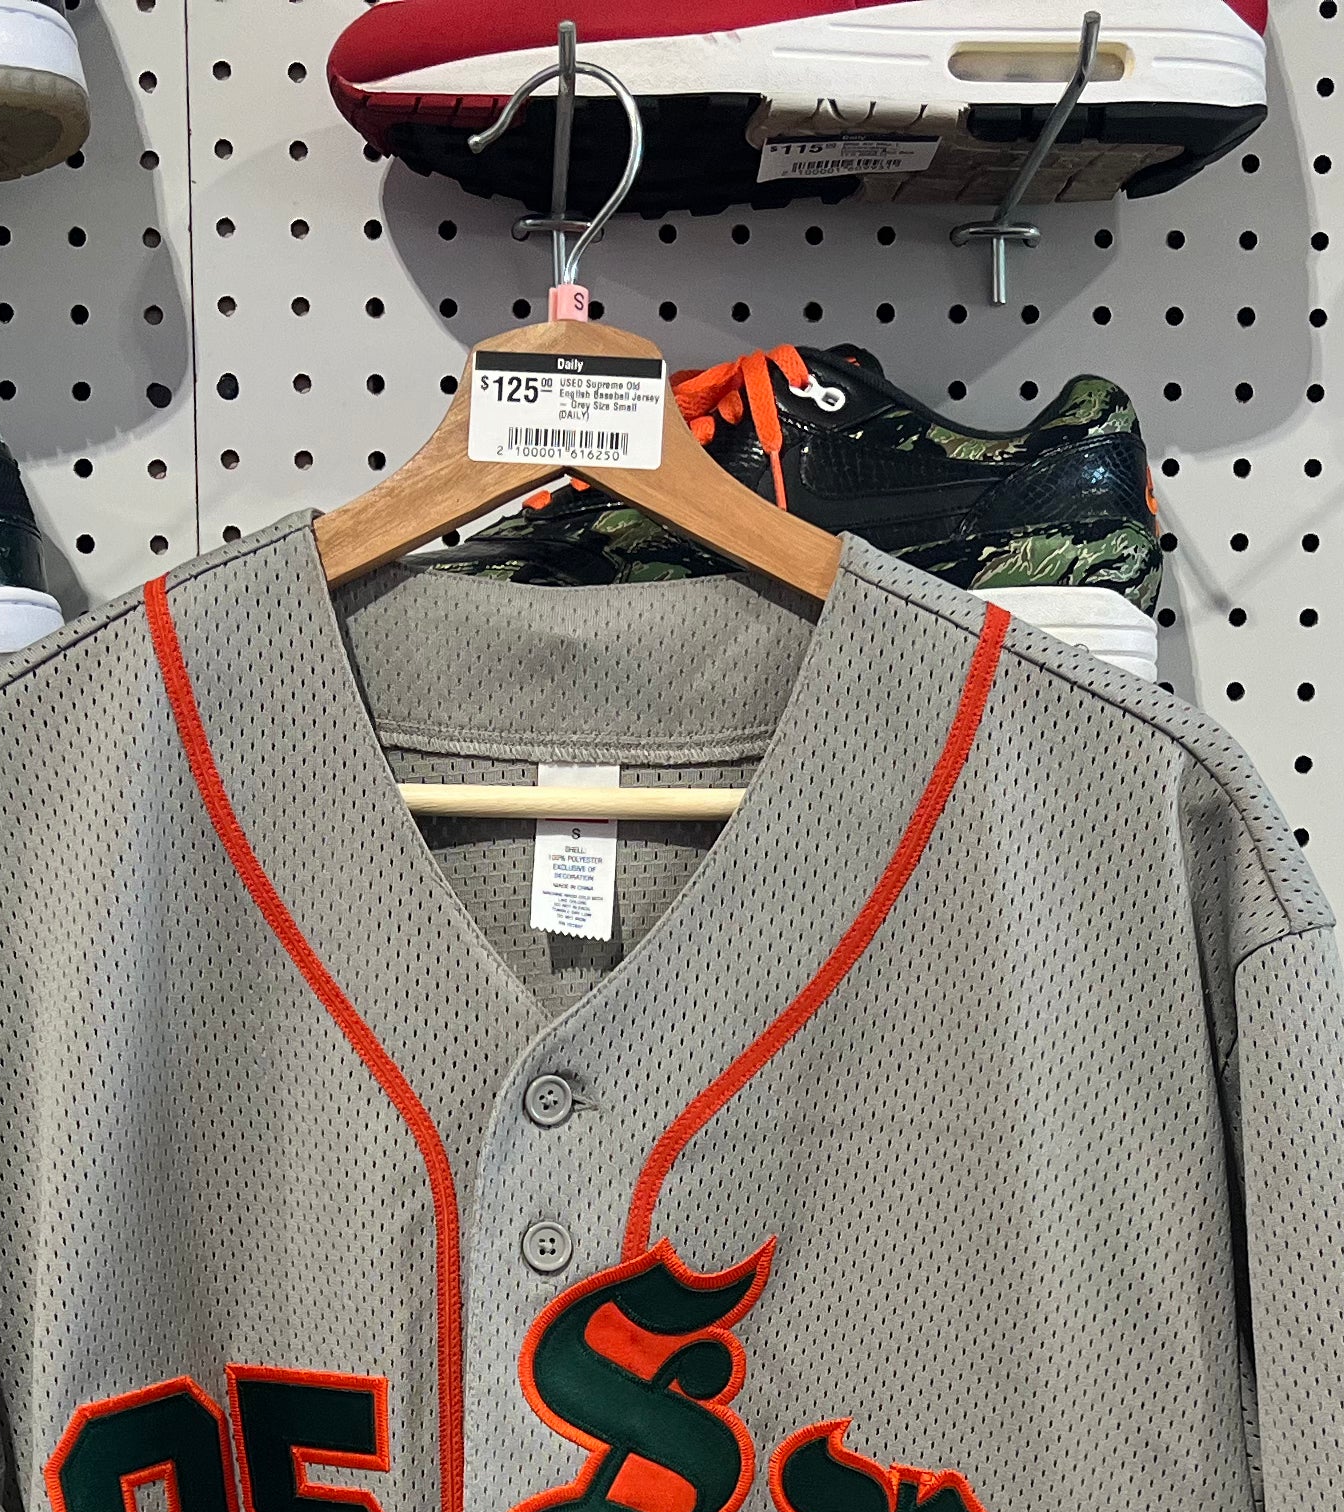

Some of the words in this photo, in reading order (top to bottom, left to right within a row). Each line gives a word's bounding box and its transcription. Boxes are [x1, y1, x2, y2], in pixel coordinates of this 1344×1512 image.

[574, 292, 584, 310] S
[557, 358, 584, 373] Daily
[560, 378, 583, 388] USED
[586, 380, 624, 394] Supreme
[626, 381, 640, 391] Old
[560, 389, 590, 400] English
[594, 390, 630, 401] Baseball
[632, 392, 660, 404] Jersey
[570, 400, 590, 412] Grey
[593, 402, 610, 411] Size
[613, 402, 637, 412] Small
[558, 410, 590, 422] (DAILY)
[496, 445, 504, 456] 2
[516, 446, 562, 458] 100001
[570, 448, 620, 461] 616250
[572, 828, 581, 840] S
